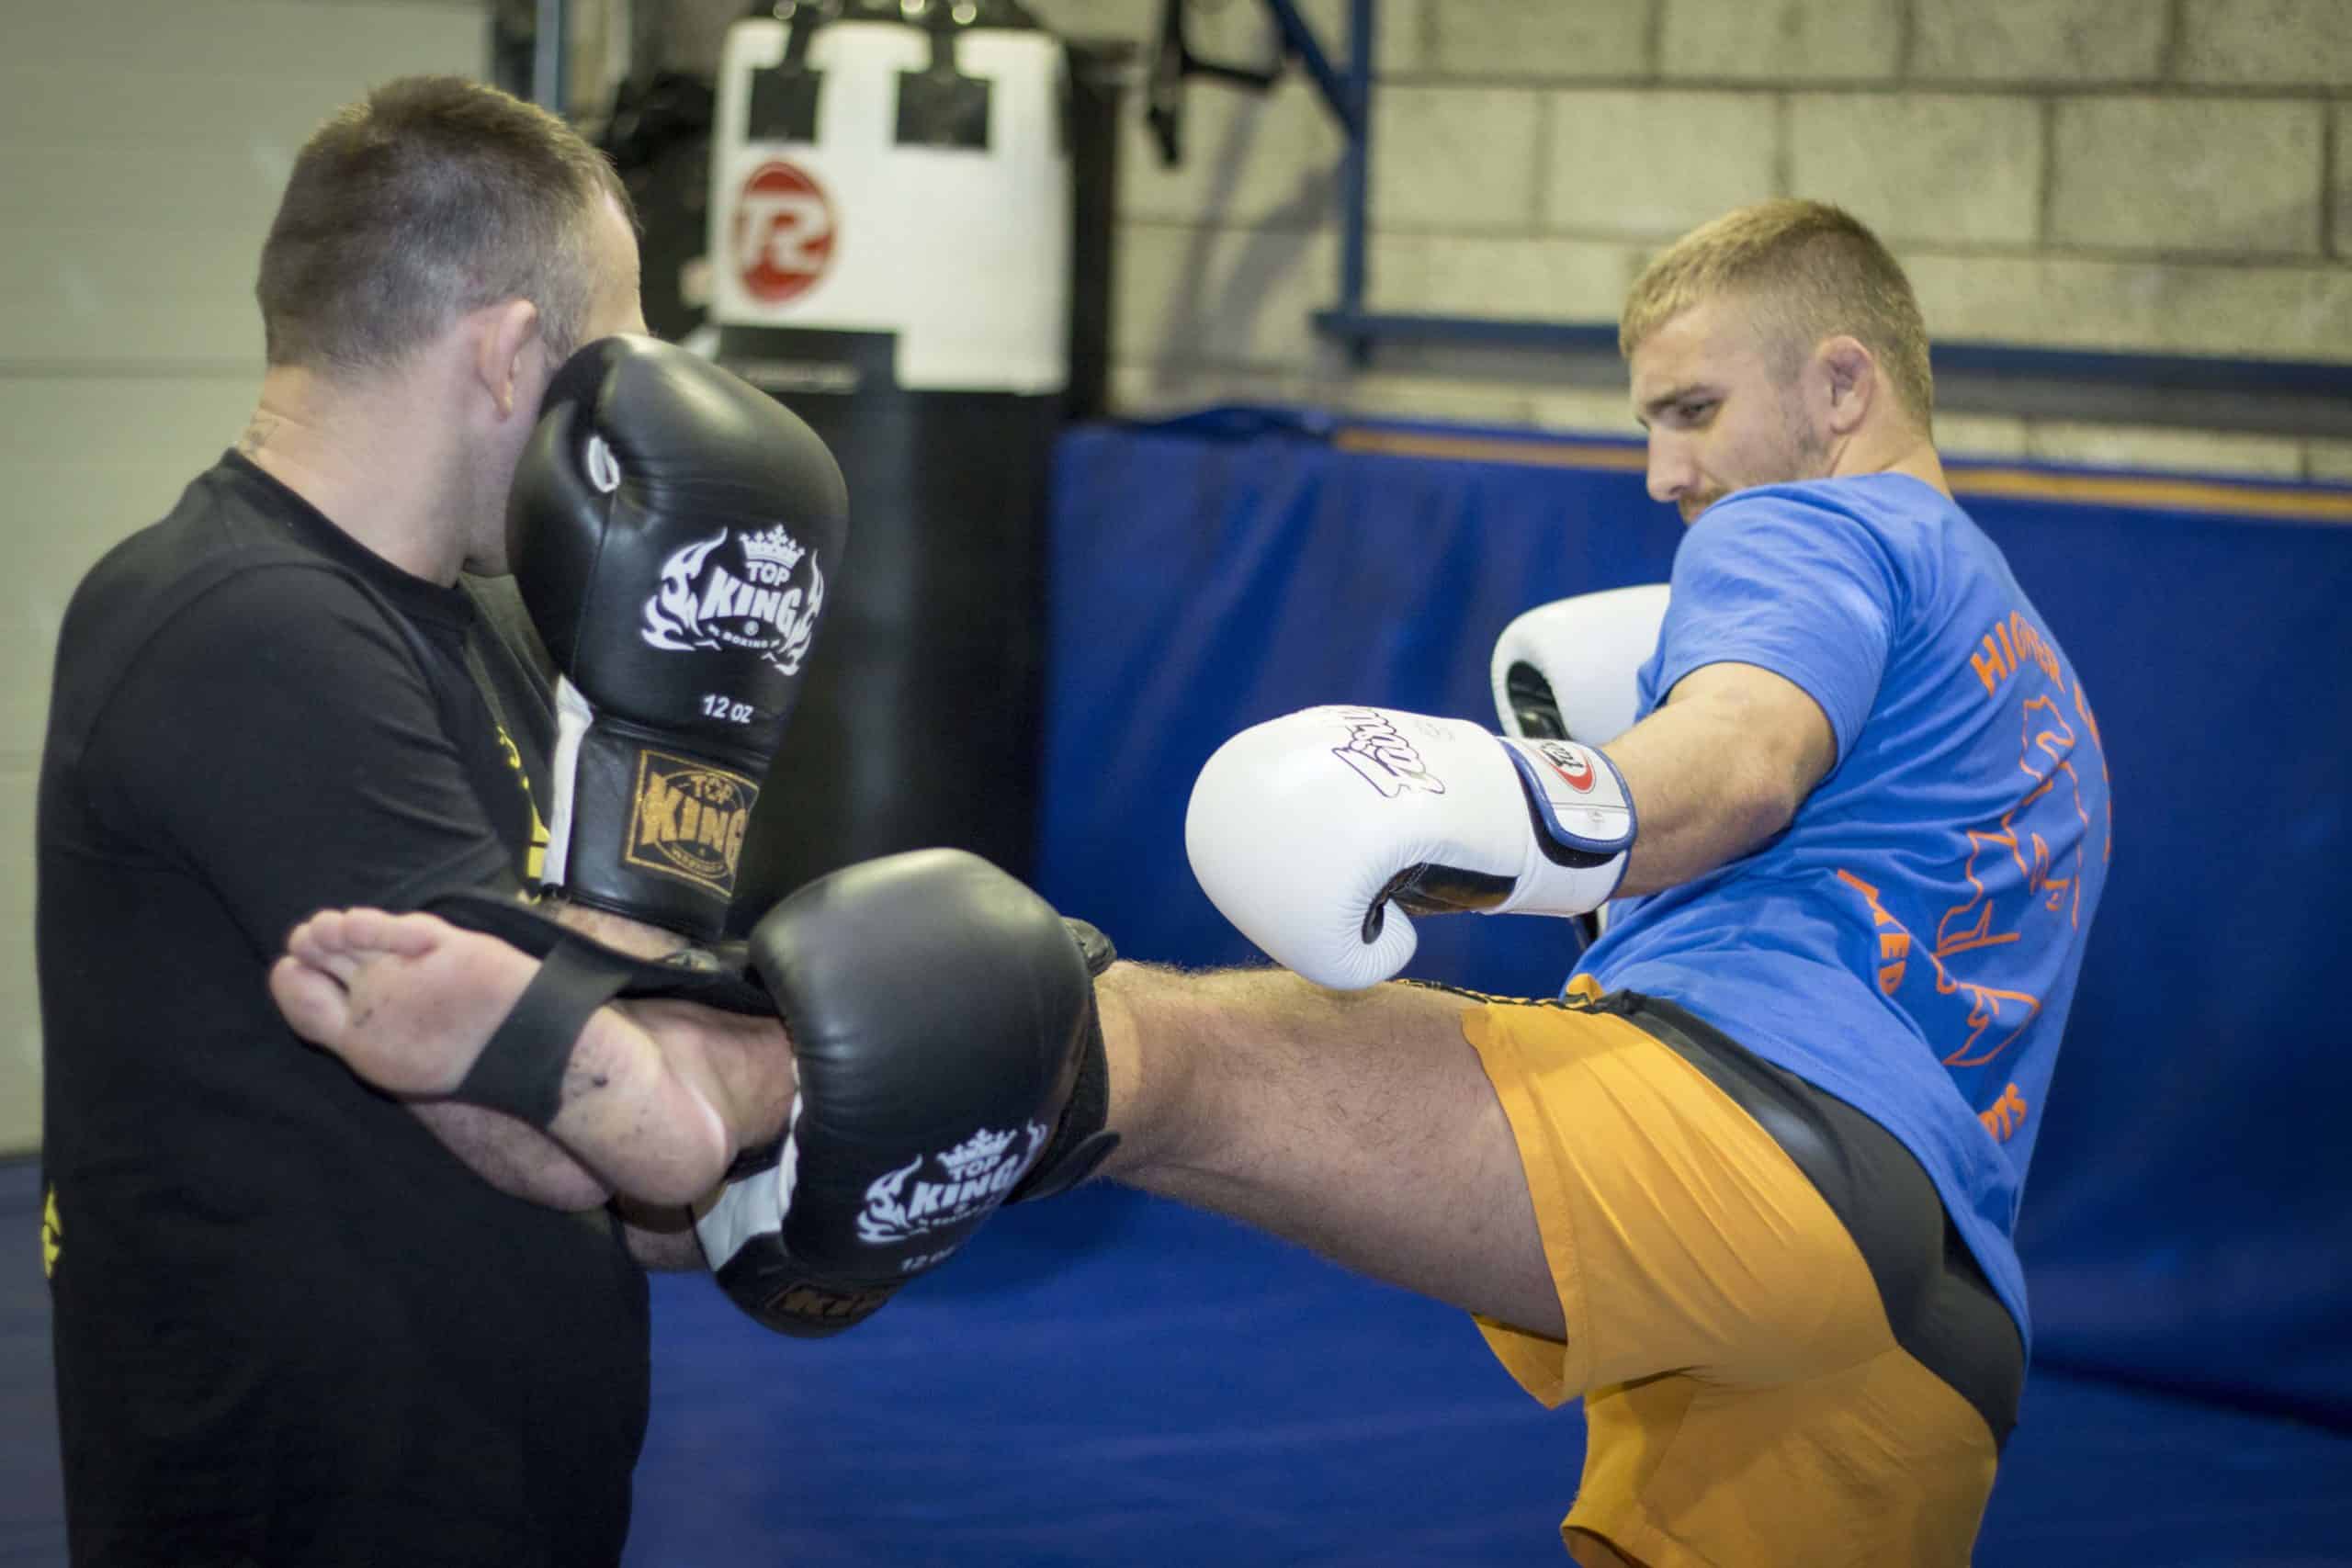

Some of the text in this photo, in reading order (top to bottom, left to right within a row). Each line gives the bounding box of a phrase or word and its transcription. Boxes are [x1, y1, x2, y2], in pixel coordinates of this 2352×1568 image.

[745, 561, 791, 587] TOP
[698, 565, 803, 641] KING
[703, 694, 730, 718] 12
[690, 773, 735, 805] TOP
[948, 1154, 1001, 1181] TOP
[907, 1154, 1019, 1220] KING
